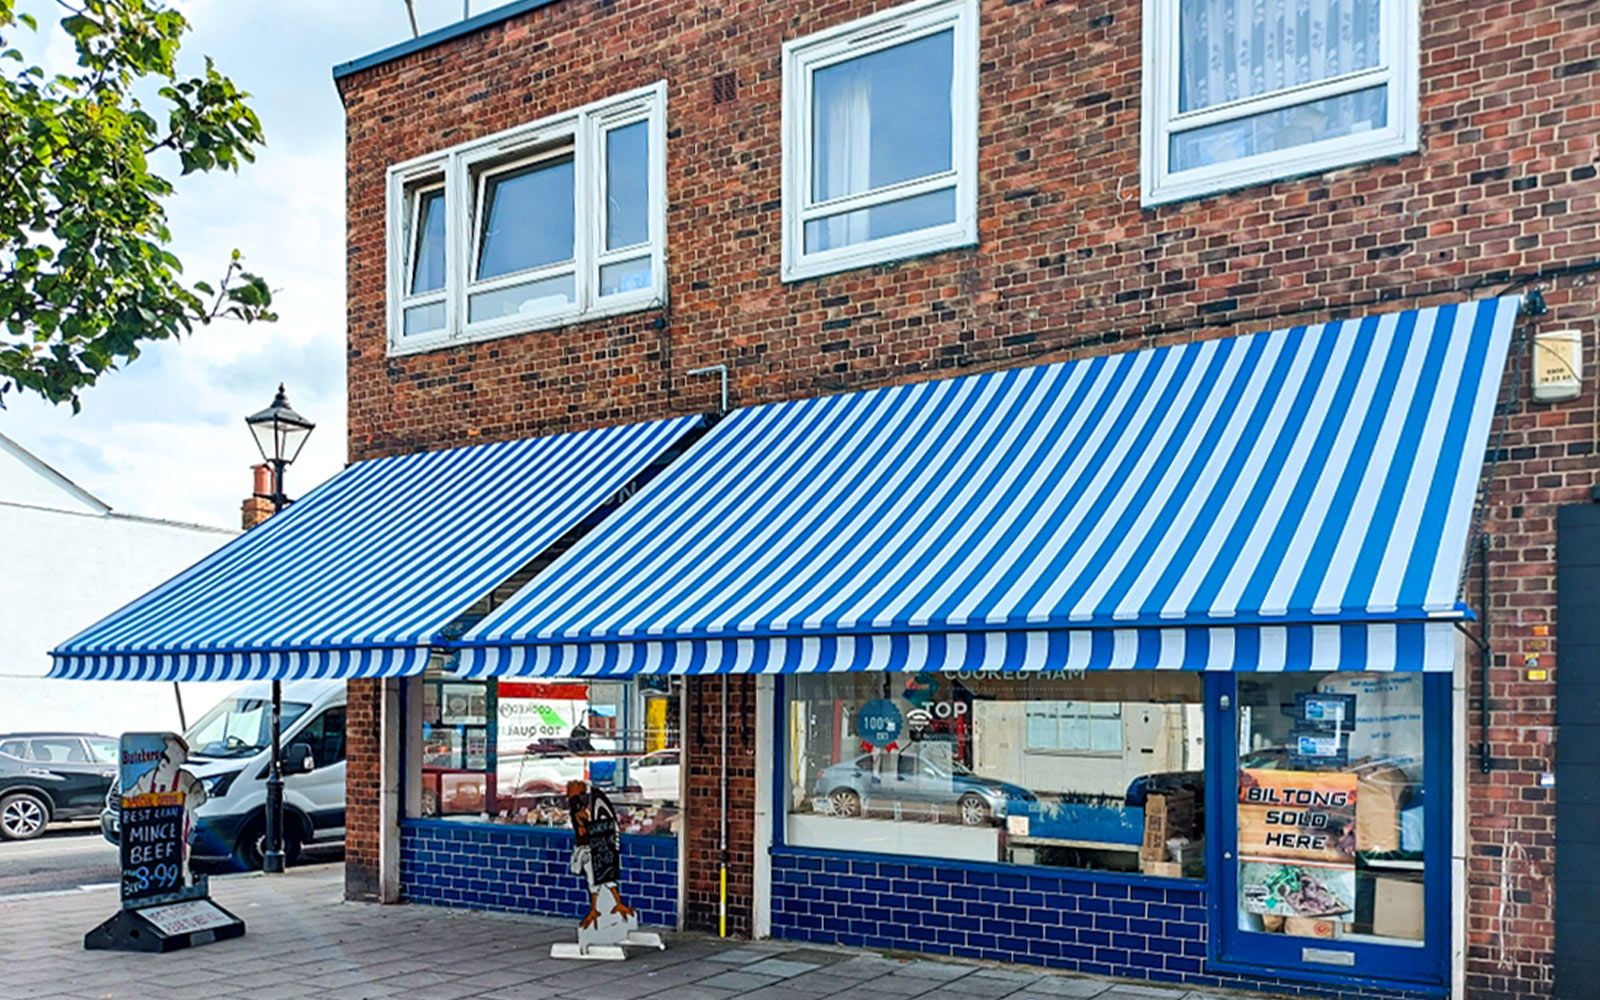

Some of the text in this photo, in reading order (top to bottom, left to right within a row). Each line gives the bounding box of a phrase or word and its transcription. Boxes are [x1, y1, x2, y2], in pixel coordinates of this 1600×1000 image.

[944, 669, 1086, 681] COOKED HAM
[921, 702, 969, 719] TOP
[1246, 786, 1348, 807] BILTONG
[122, 809, 152, 824] BEST
[1265, 810, 1328, 828] SOLD
[129, 822, 176, 842] MINCE
[1265, 832, 1327, 850] HERE
[130, 842, 176, 864] BEEF
